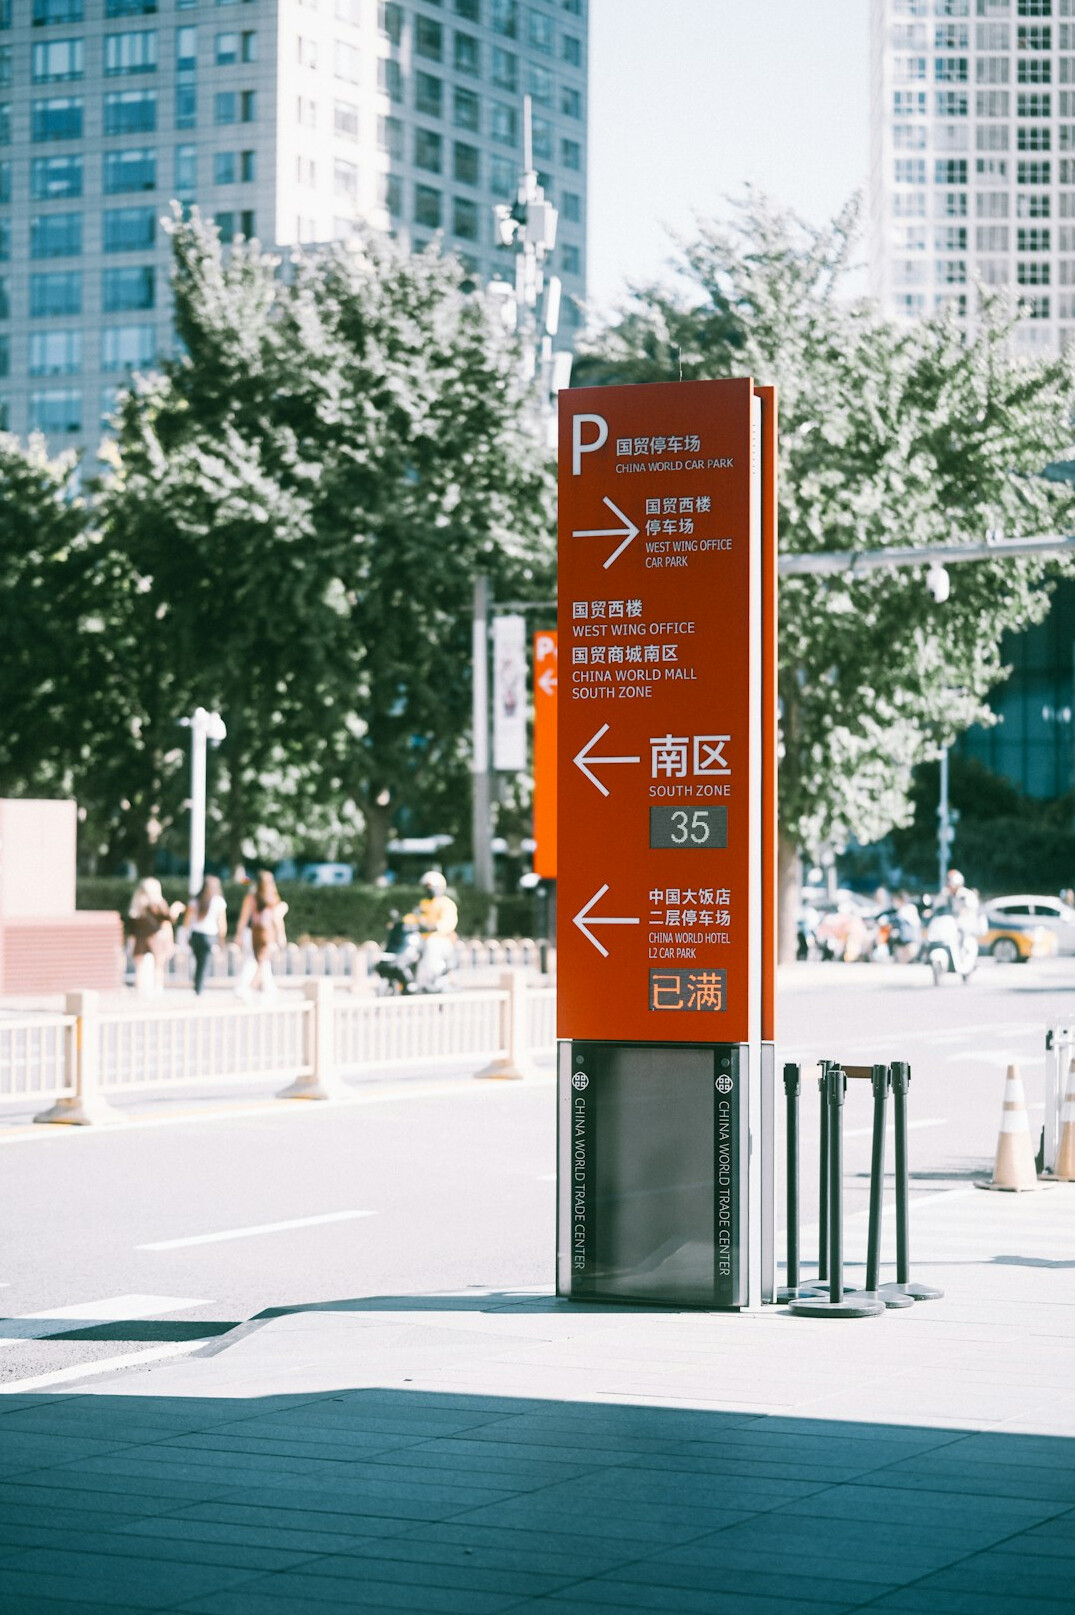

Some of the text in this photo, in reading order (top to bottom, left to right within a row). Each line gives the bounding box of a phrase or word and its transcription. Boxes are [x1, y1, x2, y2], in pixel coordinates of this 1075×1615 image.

[573, 414, 608, 475] P
[617, 435, 700, 456] 国贸停车场
[615, 458, 734, 474] CHINA WORLD CAR PARK
[646, 496, 710, 514] 国贸西楼
[646, 518, 693, 536] 停车场
[645, 538, 732, 553] WEST WING OFFICE
[645, 555, 688, 569] CAR PARK
[573, 599, 642, 619] 国贸西楼
[572, 621, 695, 637] WEST WING OFFICE
[572, 645, 678, 664] 国贸商城南区
[571, 668, 697, 683] CHINA WORLD MALL
[572, 685, 652, 700] SOUTH ZONE
[650, 734, 731, 778] 南区
[649, 784, 731, 797] SOUTH ZONE
[671, 811, 709, 843] 35
[649, 888, 730, 905] 中国大饭店
[649, 910, 730, 926] 二层停车场
[648, 932, 731, 944] CHINA WORLD HOTEL
[648, 947, 697, 959] L2 CAR PARK
[652, 972, 722, 1011] 已满
[574, 1097, 586, 1269] CHINA WORLD TRADE CENTER
[718, 1101, 731, 1276] CHINA WORLD TRADE CENTER
